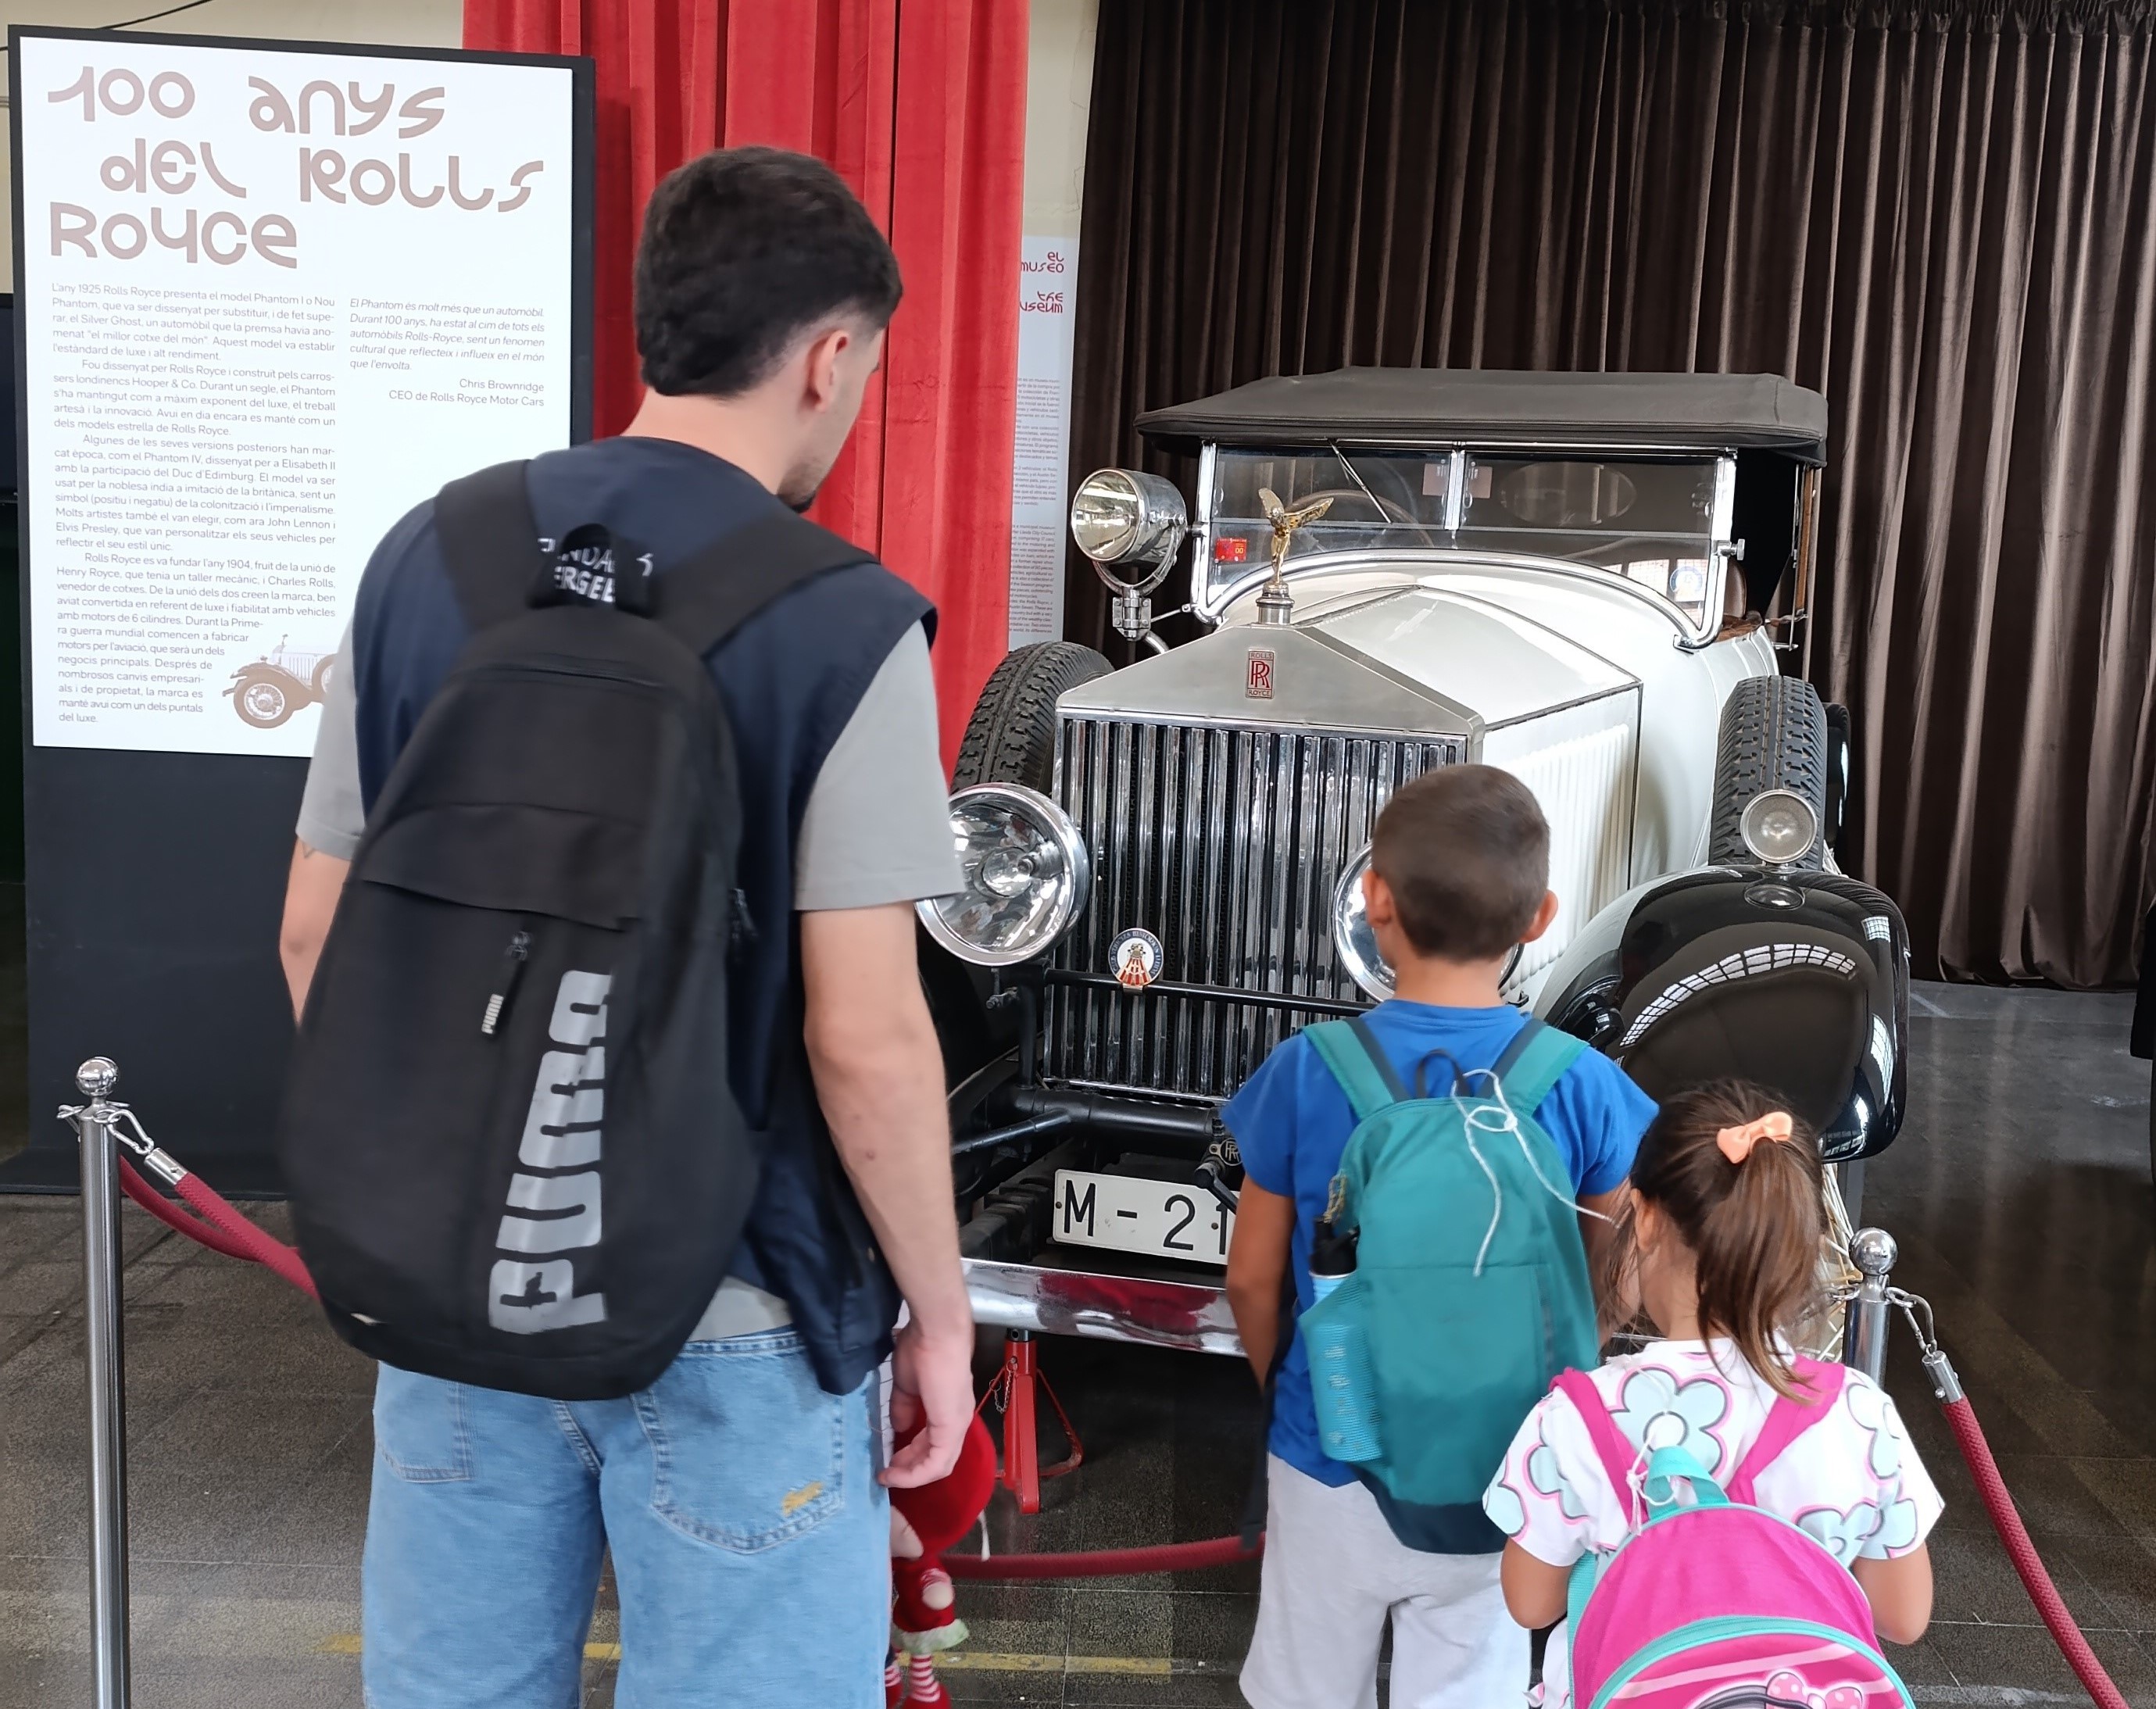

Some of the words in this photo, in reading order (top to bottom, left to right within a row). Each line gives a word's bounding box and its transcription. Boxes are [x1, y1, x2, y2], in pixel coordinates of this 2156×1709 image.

[48, 66, 195, 122] 100
[248, 76, 445, 139] anys
[78, 283, 101, 294] 1925
[103, 284, 128, 295] Rolls
[130, 286, 161, 299] Royce
[163, 290, 207, 300] presenta
[220, 292, 252, 302] model
[254, 292, 299, 305] Phantom
[154, 302, 202, 316] dissenyat
[349, 298, 359, 308] El
[360, 299, 403, 309] Phantom
[417, 302, 439, 312] molt
[463, 306, 481, 316] que
[80, 313, 109, 324] Silver
[244, 324, 282, 334] premsa
[284, 324, 310, 335] havia
[349, 313, 383, 324] Durant
[384, 314, 402, 325] 100
[429, 317, 442, 327] ha
[443, 319, 467, 328] estat
[467, 320, 477, 329] al
[477, 321, 496, 330] cim
[497, 320, 510, 331] de
[512, 322, 529, 331] tots
[531, 323, 545, 332] els
[102, 331, 131, 341] millor
[133, 333, 160, 342] cotxe
[212, 336, 248, 348] Aquest
[250, 338, 282, 349] model
[299, 341, 335, 351] establir
[467, 335, 488, 344] sent
[502, 335, 545, 347] fenomen
[349, 343, 386, 354] cultural
[388, 347, 406, 357] que
[409, 346, 453, 357] reflecteix
[460, 349, 495, 359] influeix
[511, 352, 521, 361] el
[102, 360, 149, 374] dissenyat
[170, 363, 194, 374] Rolls
[195, 364, 227, 377] Royce
[349, 360, 369, 370] que
[76, 374, 130, 386] londinencs
[132, 376, 169, 389] Hooper
[200, 380, 234, 391] Durant
[291, 384, 335, 396] Phantom
[459, 377, 485, 389] Chris
[488, 379, 544, 394] Brownridge
[76, 391, 127, 402] mantingut
[200, 397, 247, 407] exponent
[388, 389, 413, 400] CEO
[415, 391, 427, 401] de
[430, 391, 455, 402] Rolls
[456, 392, 487, 406] Royce
[489, 395, 519, 405] Motor
[520, 395, 544, 406] Cars
[213, 413, 247, 422] encara
[77, 420, 115, 430] models
[116, 421, 153, 432] estrella
[171, 423, 196, 434] Rolls
[82, 434, 124, 447] Algunes
[191, 442, 234, 451] versions
[144, 452, 189, 463] Phantom
[205, 455, 252, 468] dissenyat
[281, 458, 327, 470] Elisabeth
[109, 481, 148, 491] noblesa
[271, 474, 303, 484] model
[55, 506, 84, 517] Molts
[86, 509, 123, 520] artistes
[293, 518, 331, 529] Lennon
[55, 521, 79, 532] Elvis
[165, 528, 230, 539] personalitzar
[276, 532, 316, 543] vehicles
[55, 537, 94, 548] reflectir
[84, 552, 109, 563] Rolls
[111, 553, 141, 566] Royce
[169, 556, 201, 567] fundar
[56, 566, 87, 579] Henry
[188, 572, 213, 582] taller
[267, 575, 306, 586] Charles
[56, 581, 96, 592] venedor
[81, 599, 134, 608] convertida
[149, 599, 188, 610] referent
[231, 602, 270, 614] fiabilitat
[295, 606, 335, 617] vehicles
[80, 612, 116, 622] motors
[185, 615, 219, 626] Durant
[69, 627, 102, 637] guerra
[105, 627, 145, 638] mundial
[147, 631, 200, 640] comencen
[211, 631, 249, 642] fabricar
[57, 641, 91, 650] motors
[57, 656, 98, 667] negocis
[58, 670, 114, 680] nombrosos
[116, 672, 148, 681] canvis
[157, 689, 189, 698] marca
[168, 703, 203, 713] puntals
